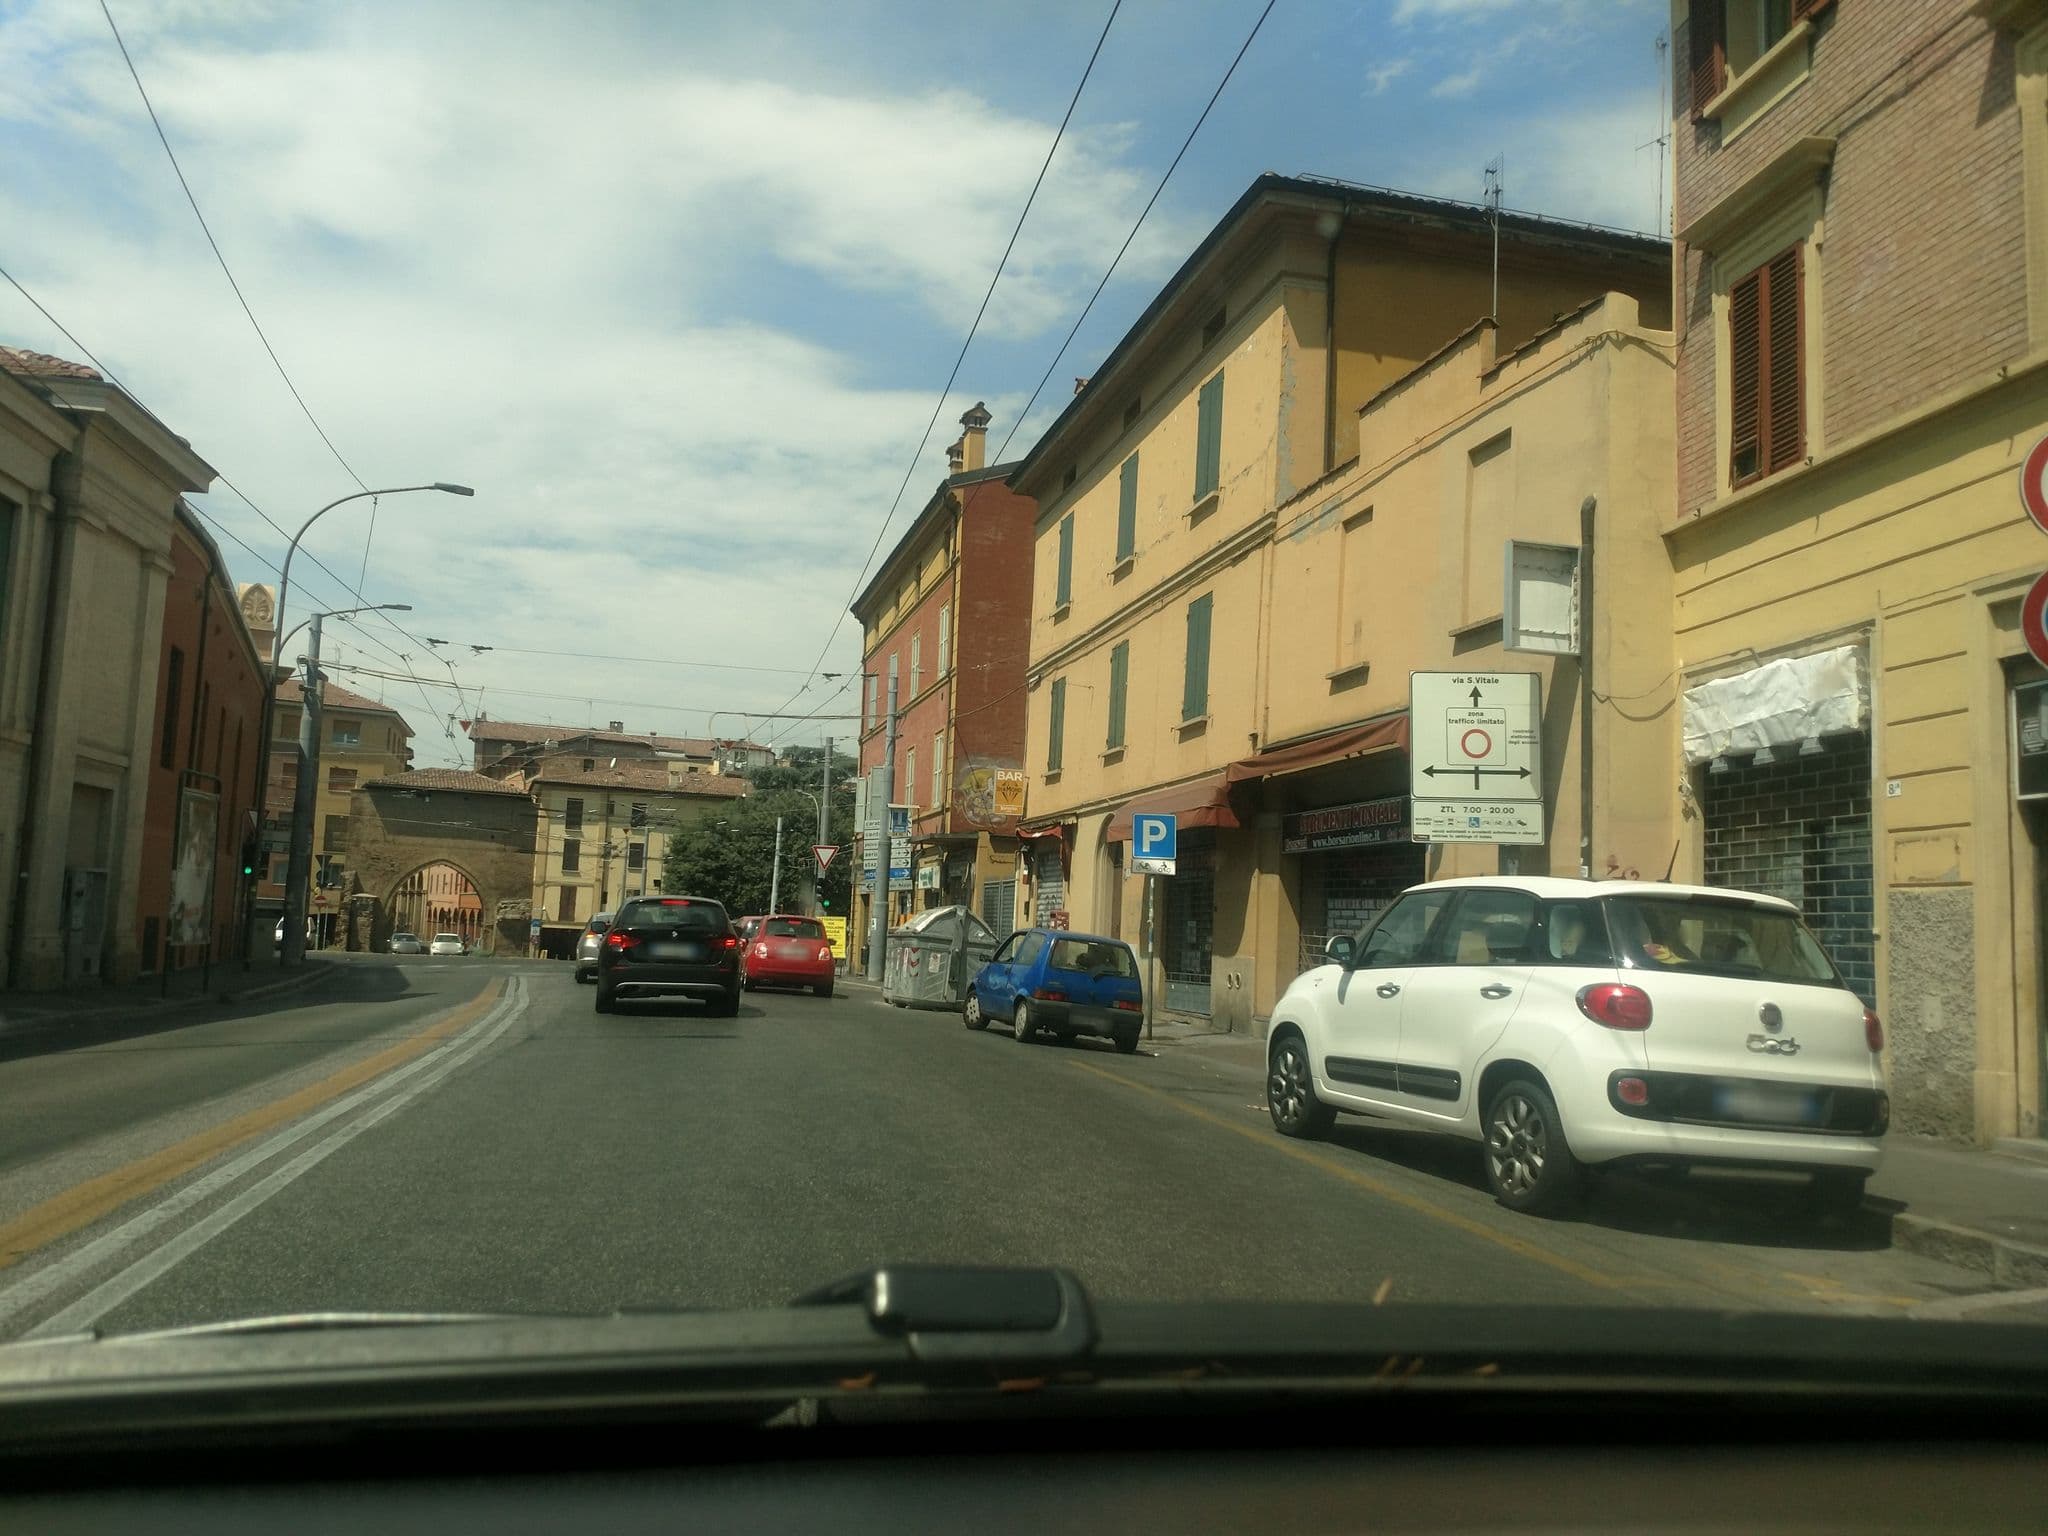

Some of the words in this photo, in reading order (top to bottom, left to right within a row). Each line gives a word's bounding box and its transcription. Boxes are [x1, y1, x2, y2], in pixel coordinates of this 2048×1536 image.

[997, 770, 1023, 782] BAR
[1440, 805, 1456, 813] ZTL
[1142, 819, 1167, 852] P
